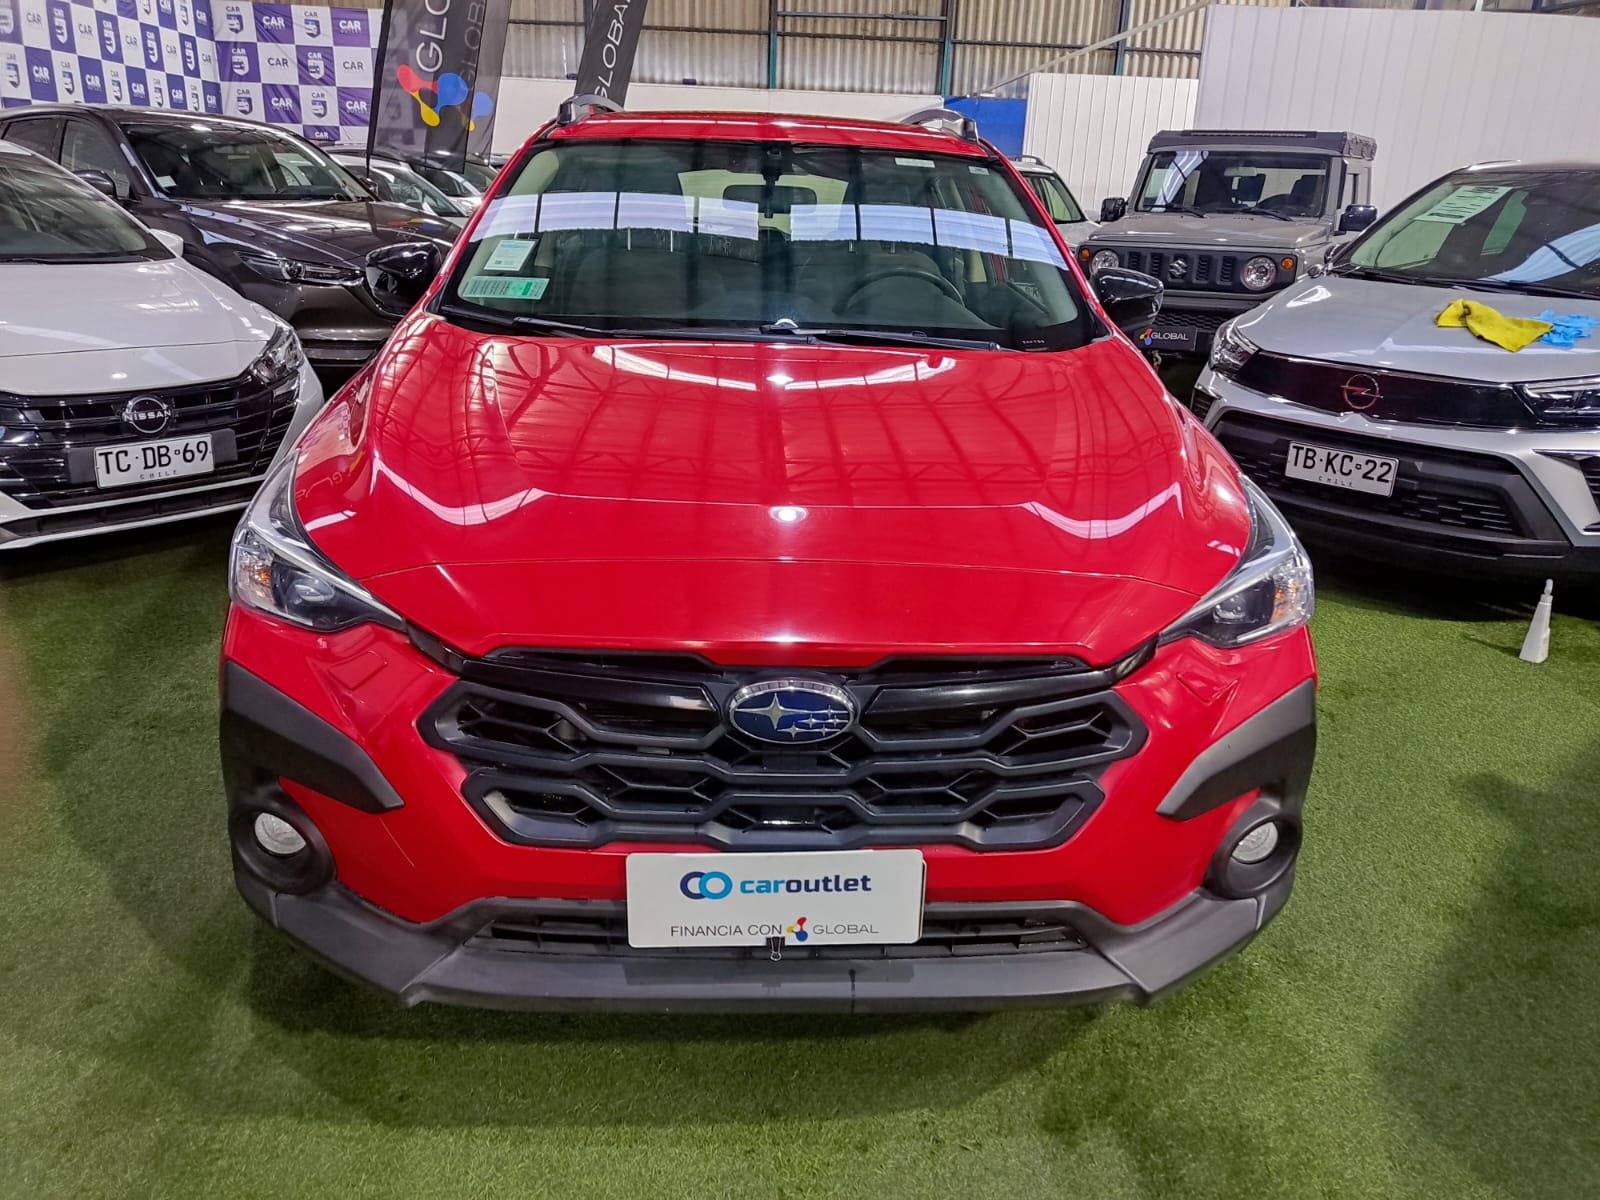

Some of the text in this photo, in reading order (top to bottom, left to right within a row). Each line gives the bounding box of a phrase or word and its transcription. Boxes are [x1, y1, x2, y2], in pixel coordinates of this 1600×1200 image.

[26, 12, 42, 24] CAR
[262, 16, 285, 27] CAR
[78, 24, 93, 35] CAR
[339, 20, 361, 30] CAR
[125, 35, 138, 46] CAR
[166, 44, 177, 55] CAR
[202, 53, 212, 63] CAR
[267, 57, 289, 67] CAR
[343, 61, 364, 70] CAR
[32, 65, 50, 79] CAR
[85, 74, 101, 87] CAR
[131, 82, 145, 95] CAR
[271, 97, 293, 108] CAR
[345, 101, 367, 110] CAR
[1151, 331, 1189, 341] GLOBAL
[124, 409, 172, 422] NISSAN
[140, 470, 177, 480] CHILE
[1318, 475, 1353, 487] CHILE
[740, 874, 872, 894] caroutlet
[670, 923, 879, 937] FINANCIA CON GLOBAL
